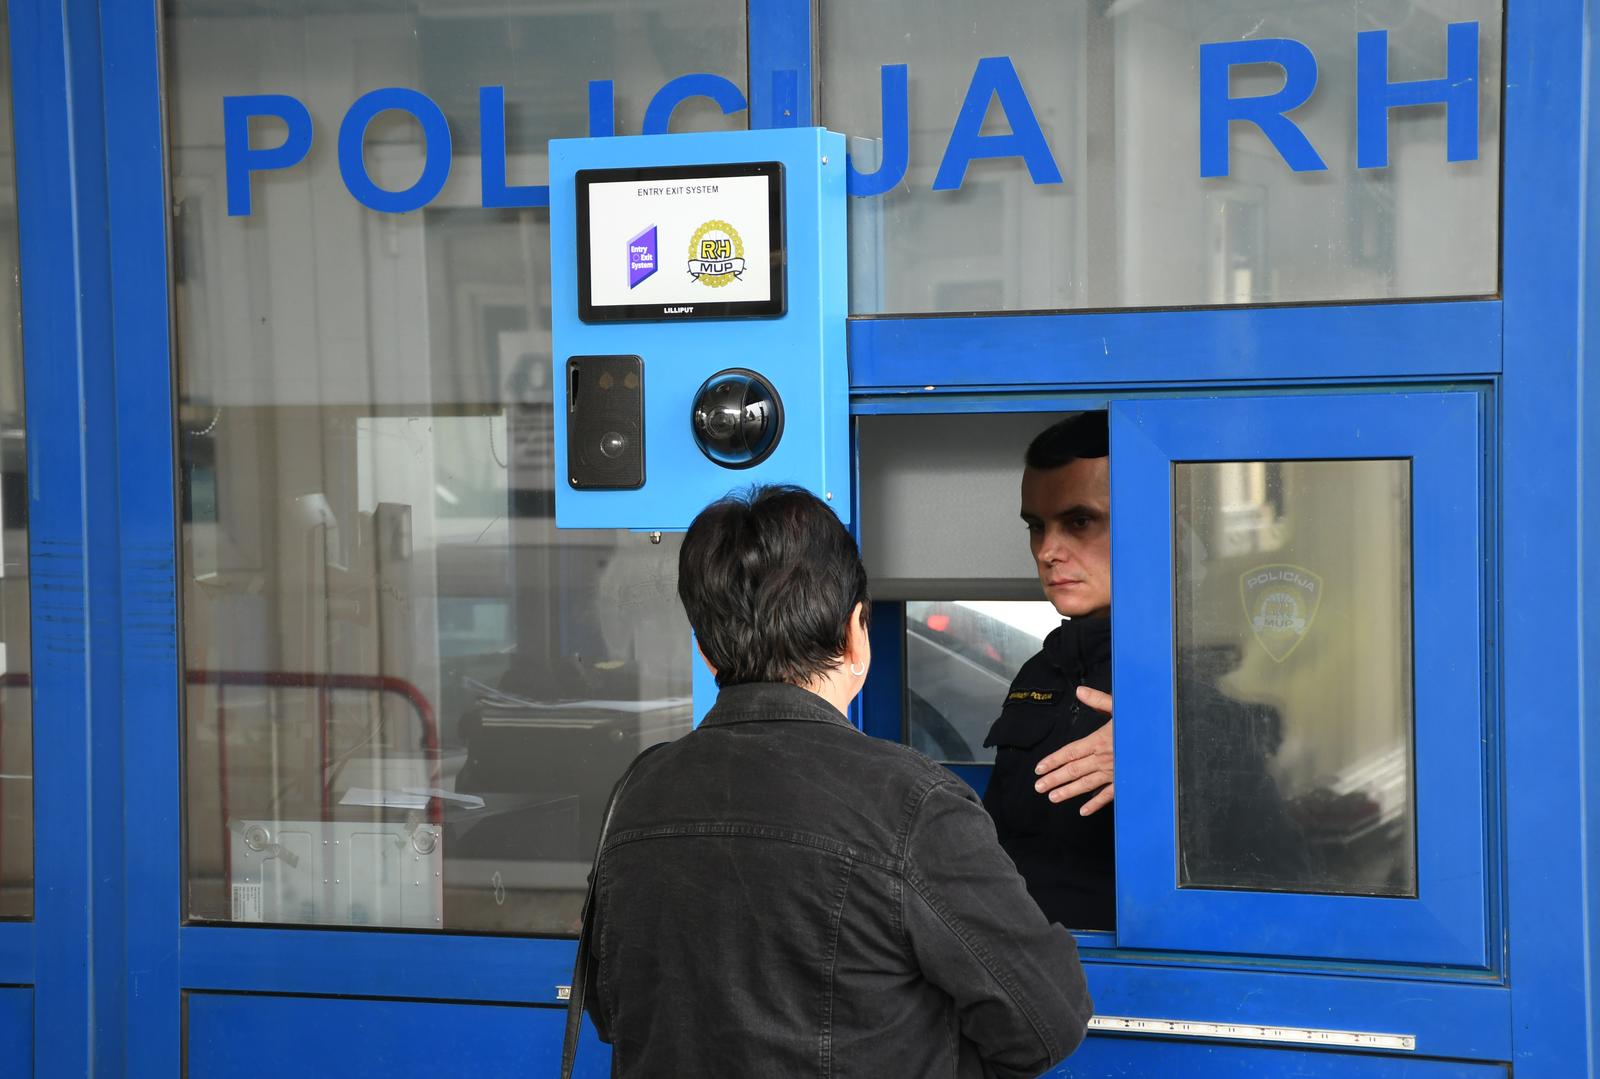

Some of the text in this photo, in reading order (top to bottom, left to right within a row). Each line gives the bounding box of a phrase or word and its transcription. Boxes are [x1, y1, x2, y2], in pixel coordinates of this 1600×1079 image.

[1199, 21, 1480, 179] RH
[637, 185, 719, 196] ENTRY EXIT SYSTEM
[631, 246, 648, 254] Entry
[701, 240, 731, 259] RH
[631, 262, 654, 270] System
[700, 262, 733, 273] MUP
[1247, 571, 1314, 592] POLICIJA
